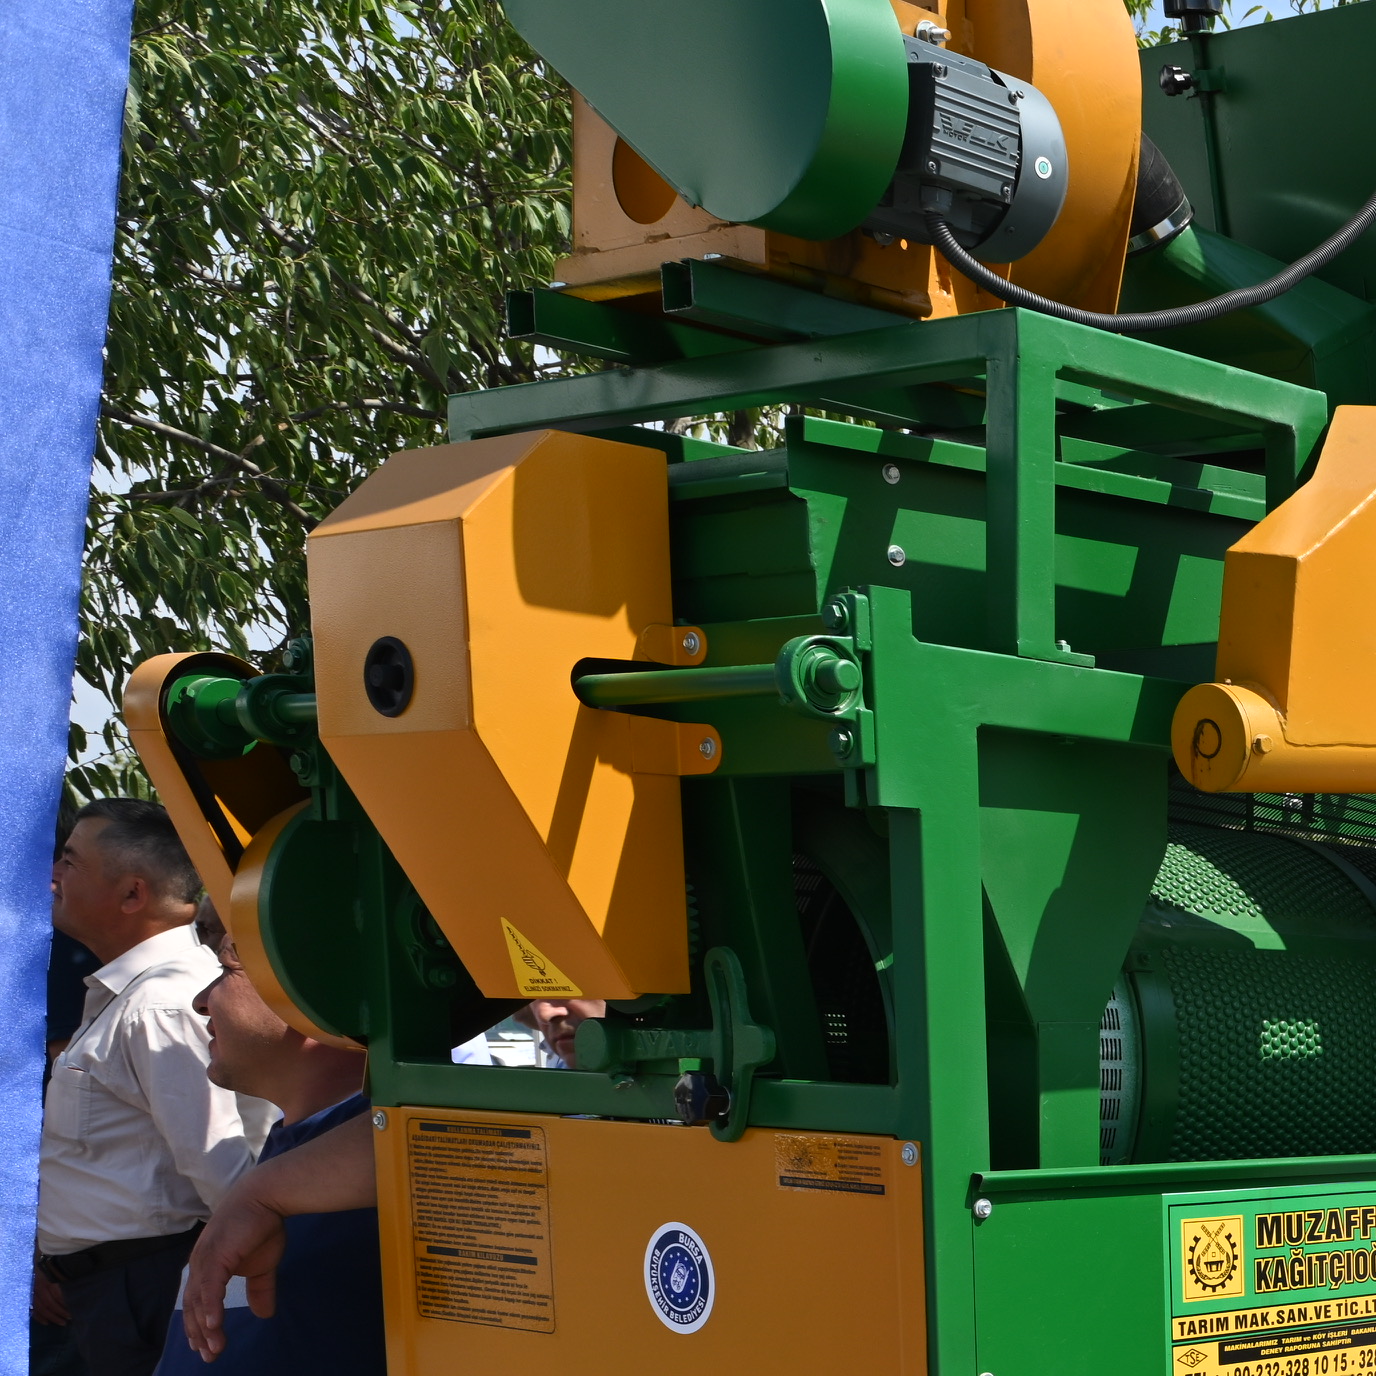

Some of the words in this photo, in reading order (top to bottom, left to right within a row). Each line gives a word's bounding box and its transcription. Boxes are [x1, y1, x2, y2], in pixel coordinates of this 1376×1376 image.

[678, 1232, 704, 1265] BURSA
[651, 1248, 671, 1314] BÜYÜKŞEHİR
[669, 1295, 706, 1323] BELEDİYESİ
[1178, 1316, 1229, 1337] TARIM
[1224, 1338, 1278, 1352] MAKİNALARIMIZ
[1281, 1335, 1303, 1344] TARIM
[1303, 1335, 1312, 1343] ve
[1312, 1330, 1327, 1341] KÖY
[1260, 1345, 1284, 1356] DENEY
[1284, 1341, 1321, 1353] RAPORUNA
[1322, 1337, 1352, 1348] SAHİPTİR
[1185, 1351, 1201, 1366] TSE
[1314, 1356, 1329, 1375] 10
[1333, 1353, 1348, 1373] 15
